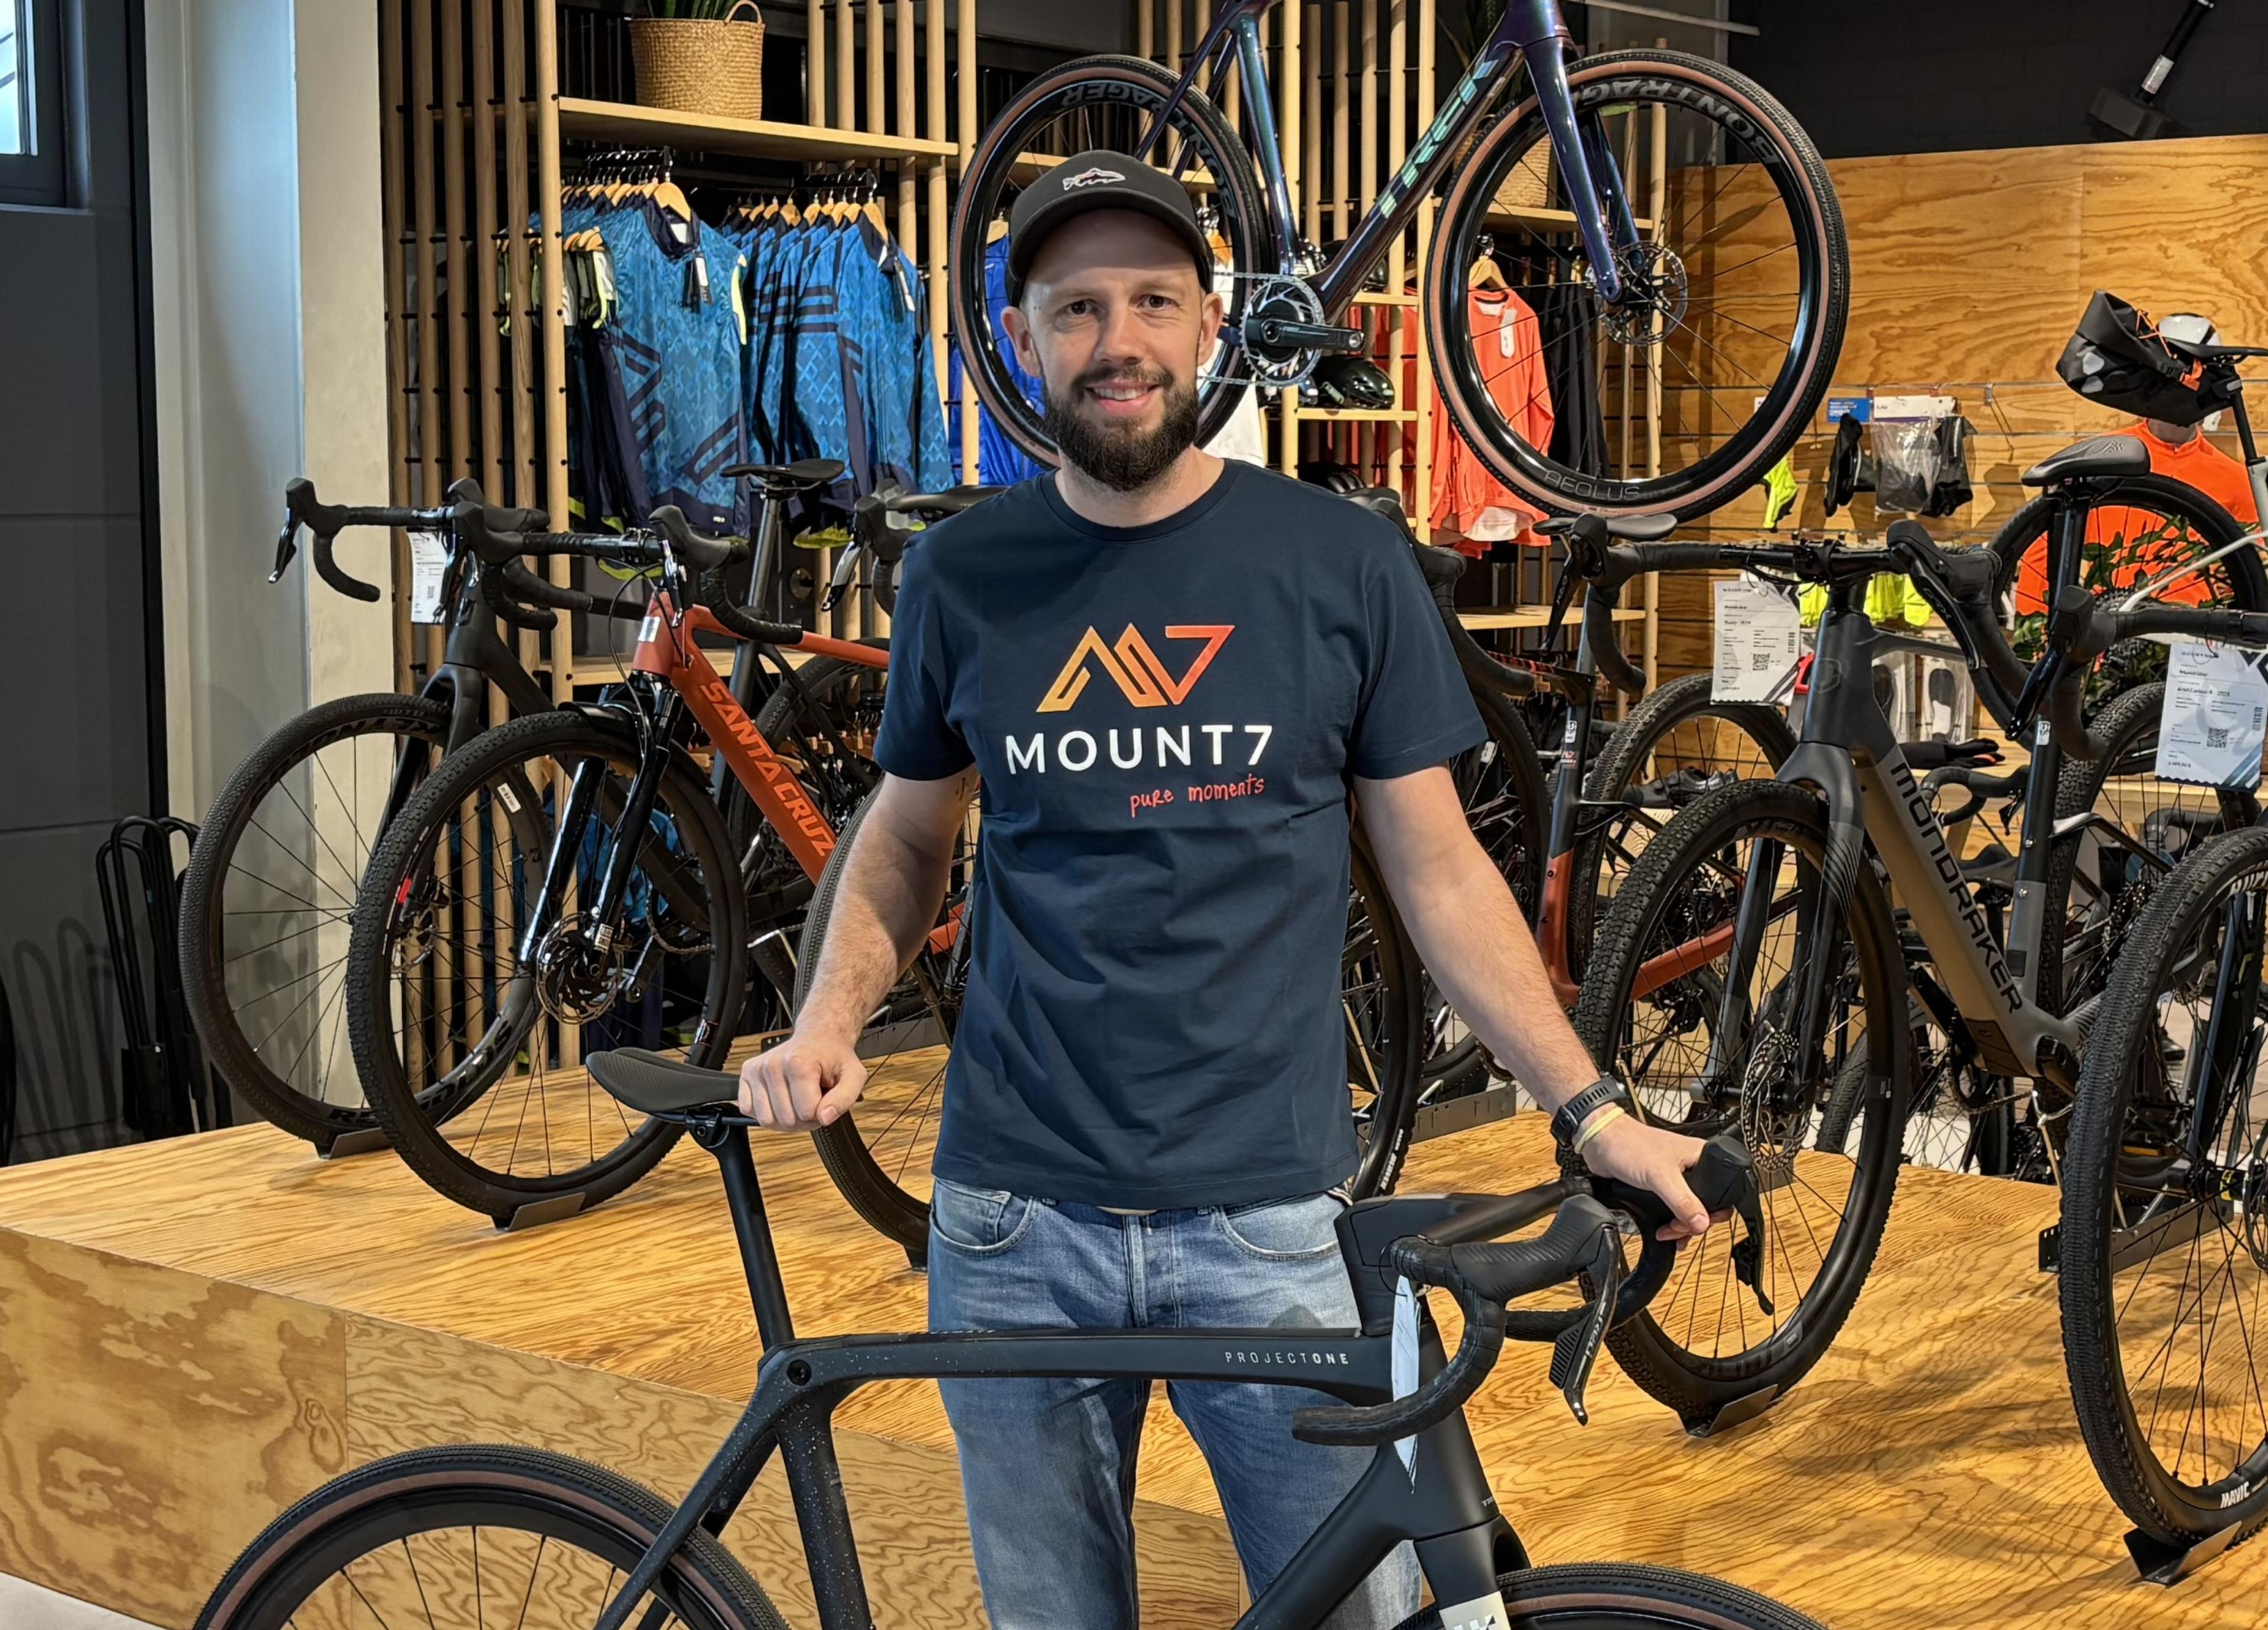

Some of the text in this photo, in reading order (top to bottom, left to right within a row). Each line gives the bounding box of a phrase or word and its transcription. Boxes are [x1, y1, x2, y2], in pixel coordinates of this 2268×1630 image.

[1377, 47, 1499, 219] TREK
[1571, 74, 1780, 165] BONTRAG
[1544, 470, 1641, 501] AEOLUS
[699, 682, 835, 857] SANTA CRUZ
[1006, 725, 1272, 774] MOUNT7
[1188, 773, 1264, 803] moments
[2220, 1481, 2250, 1508] MAVIC
